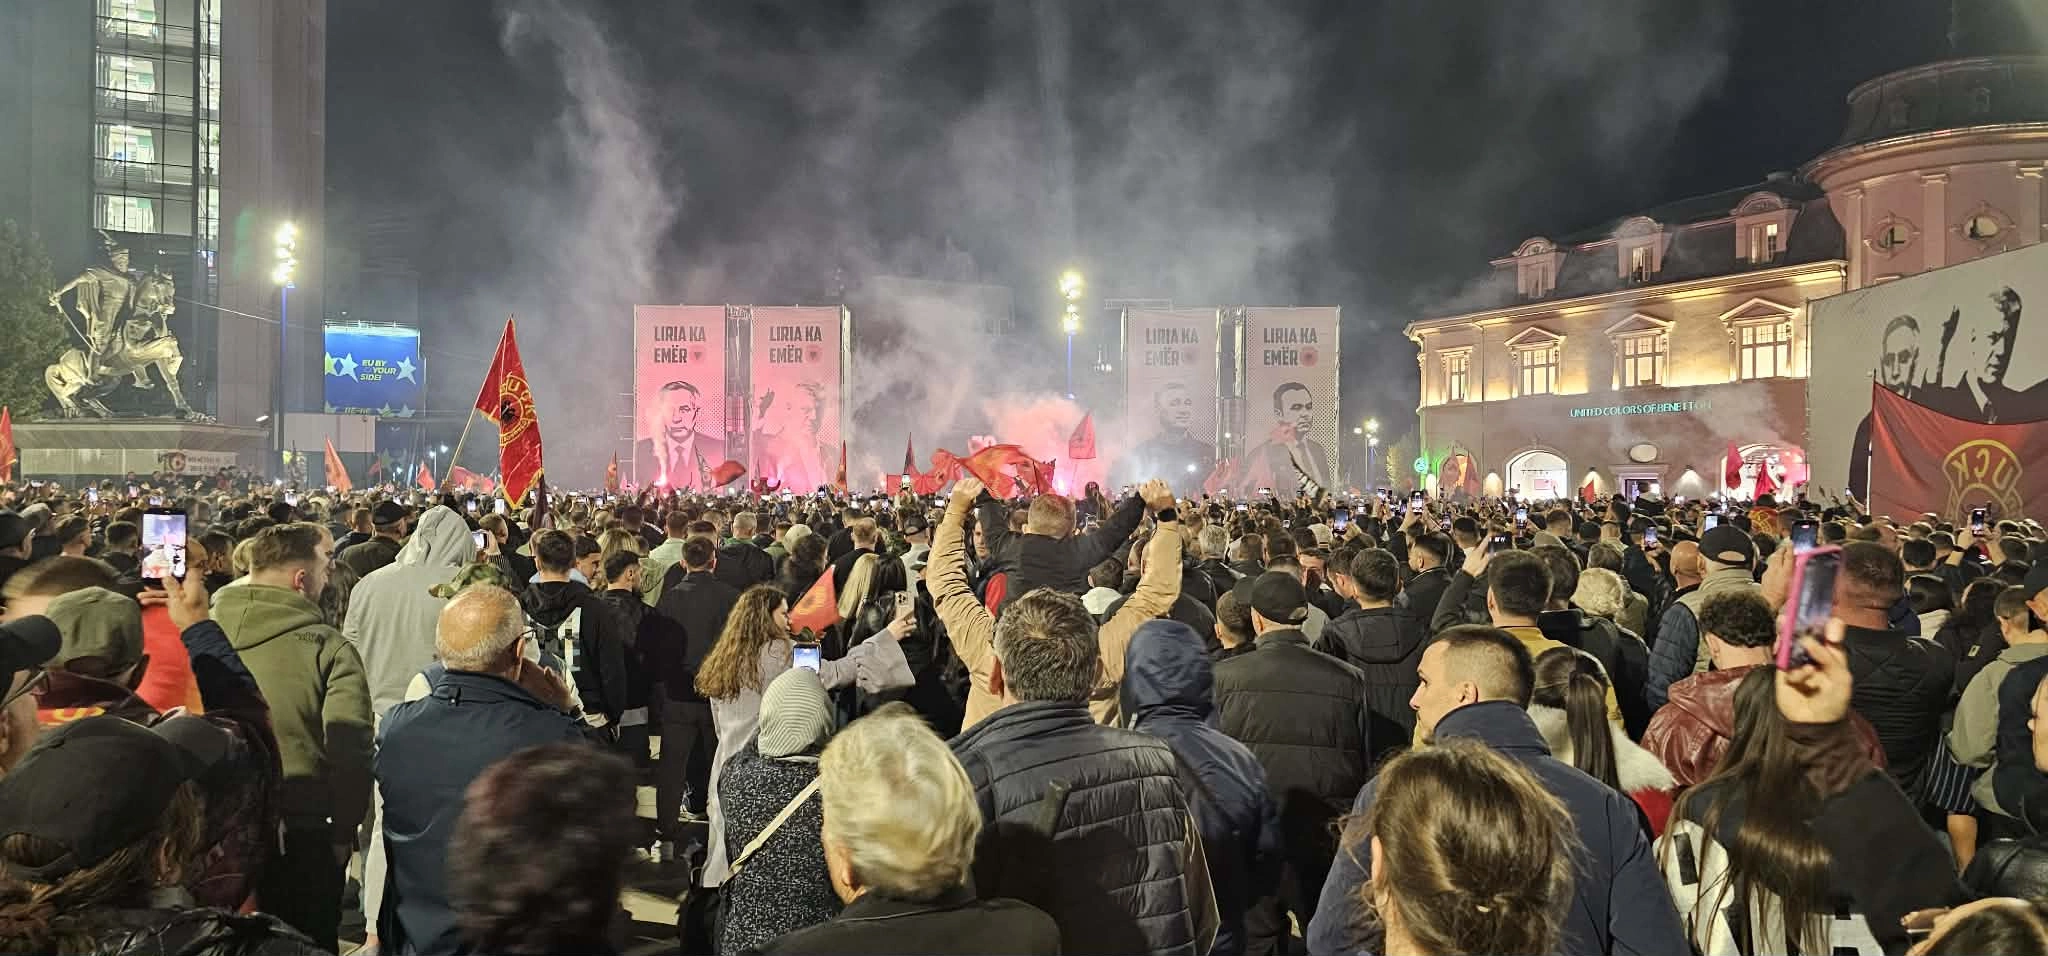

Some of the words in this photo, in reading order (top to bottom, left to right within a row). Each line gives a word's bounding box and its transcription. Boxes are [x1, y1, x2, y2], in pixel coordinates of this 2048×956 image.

[654, 326, 687, 342] LIRIA
[689, 326, 706, 342] KA
[769, 326, 802, 342] LIRIA
[805, 326, 822, 342] KA
[1145, 327, 1179, 344] LIRIA
[1181, 327, 1199, 344] KA
[1263, 327, 1298, 344] LIRIA
[1300, 327, 1318, 344] KA
[654, 344, 687, 363] EMËR
[769, 344, 803, 364] EMËR
[1263, 346, 1298, 366] EMËR
[361, 359, 374, 367] EU
[372, 367, 397, 375] YOUR
[360, 373, 382, 381] SIDE
[1570, 407, 1602, 418] UNITED
[1603, 404, 1642, 416] COLORS
[1643, 402, 1656, 414] OF
